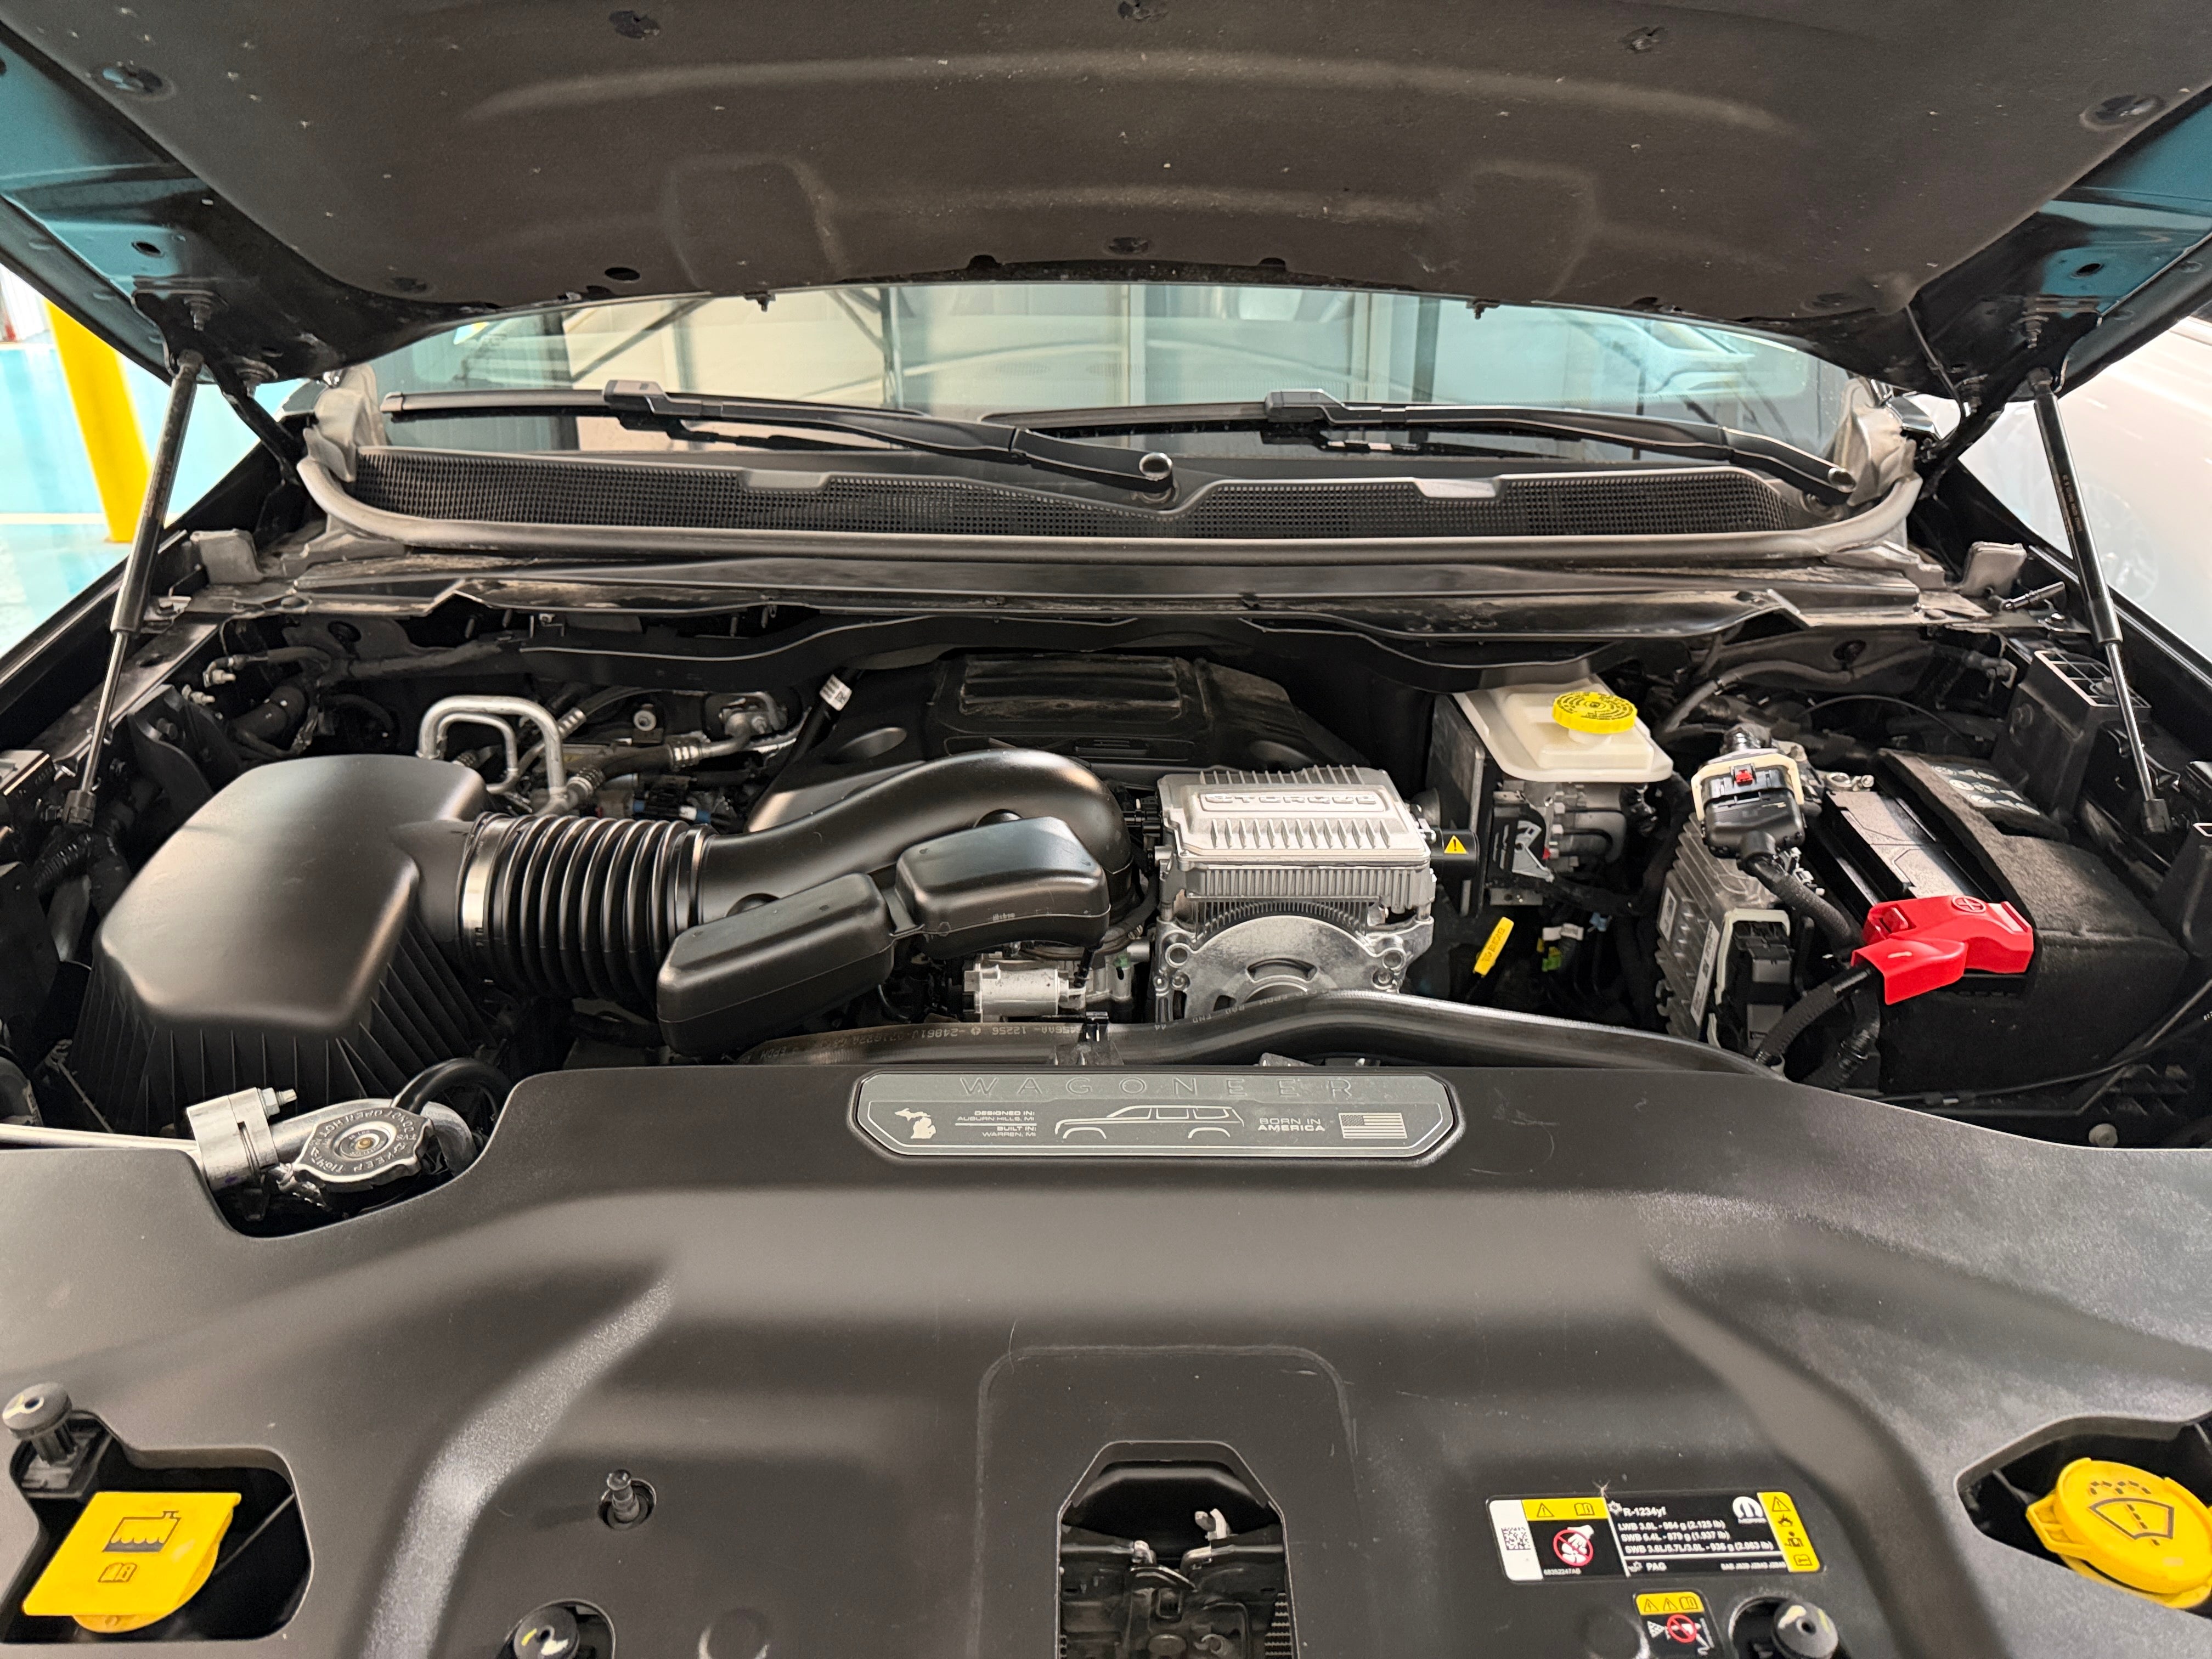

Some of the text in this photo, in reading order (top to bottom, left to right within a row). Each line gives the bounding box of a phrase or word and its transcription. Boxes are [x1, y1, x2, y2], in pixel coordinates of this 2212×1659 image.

[992, 1025, 1027, 1036] 12256
[960, 1076, 1353, 1098] WAGONEER
[1623, 1506, 1667, 1517] R-1234yf
[1618, 1522, 1638, 1531] LWB
[1639, 1522, 1657, 1530] 3.0L
[1687, 1520, 1712, 1531] (2.125
[1712, 1519, 1726, 1530] lb)
[1621, 1533, 1642, 1542] SWB
[1691, 1531, 1717, 1542] (1.937
[1717, 1530, 1731, 1541] lb)
[1624, 1545, 1646, 1554] SWB
[1760, 1541, 1774, 1551] lb)
[1646, 1561, 1667, 1572] PAG
